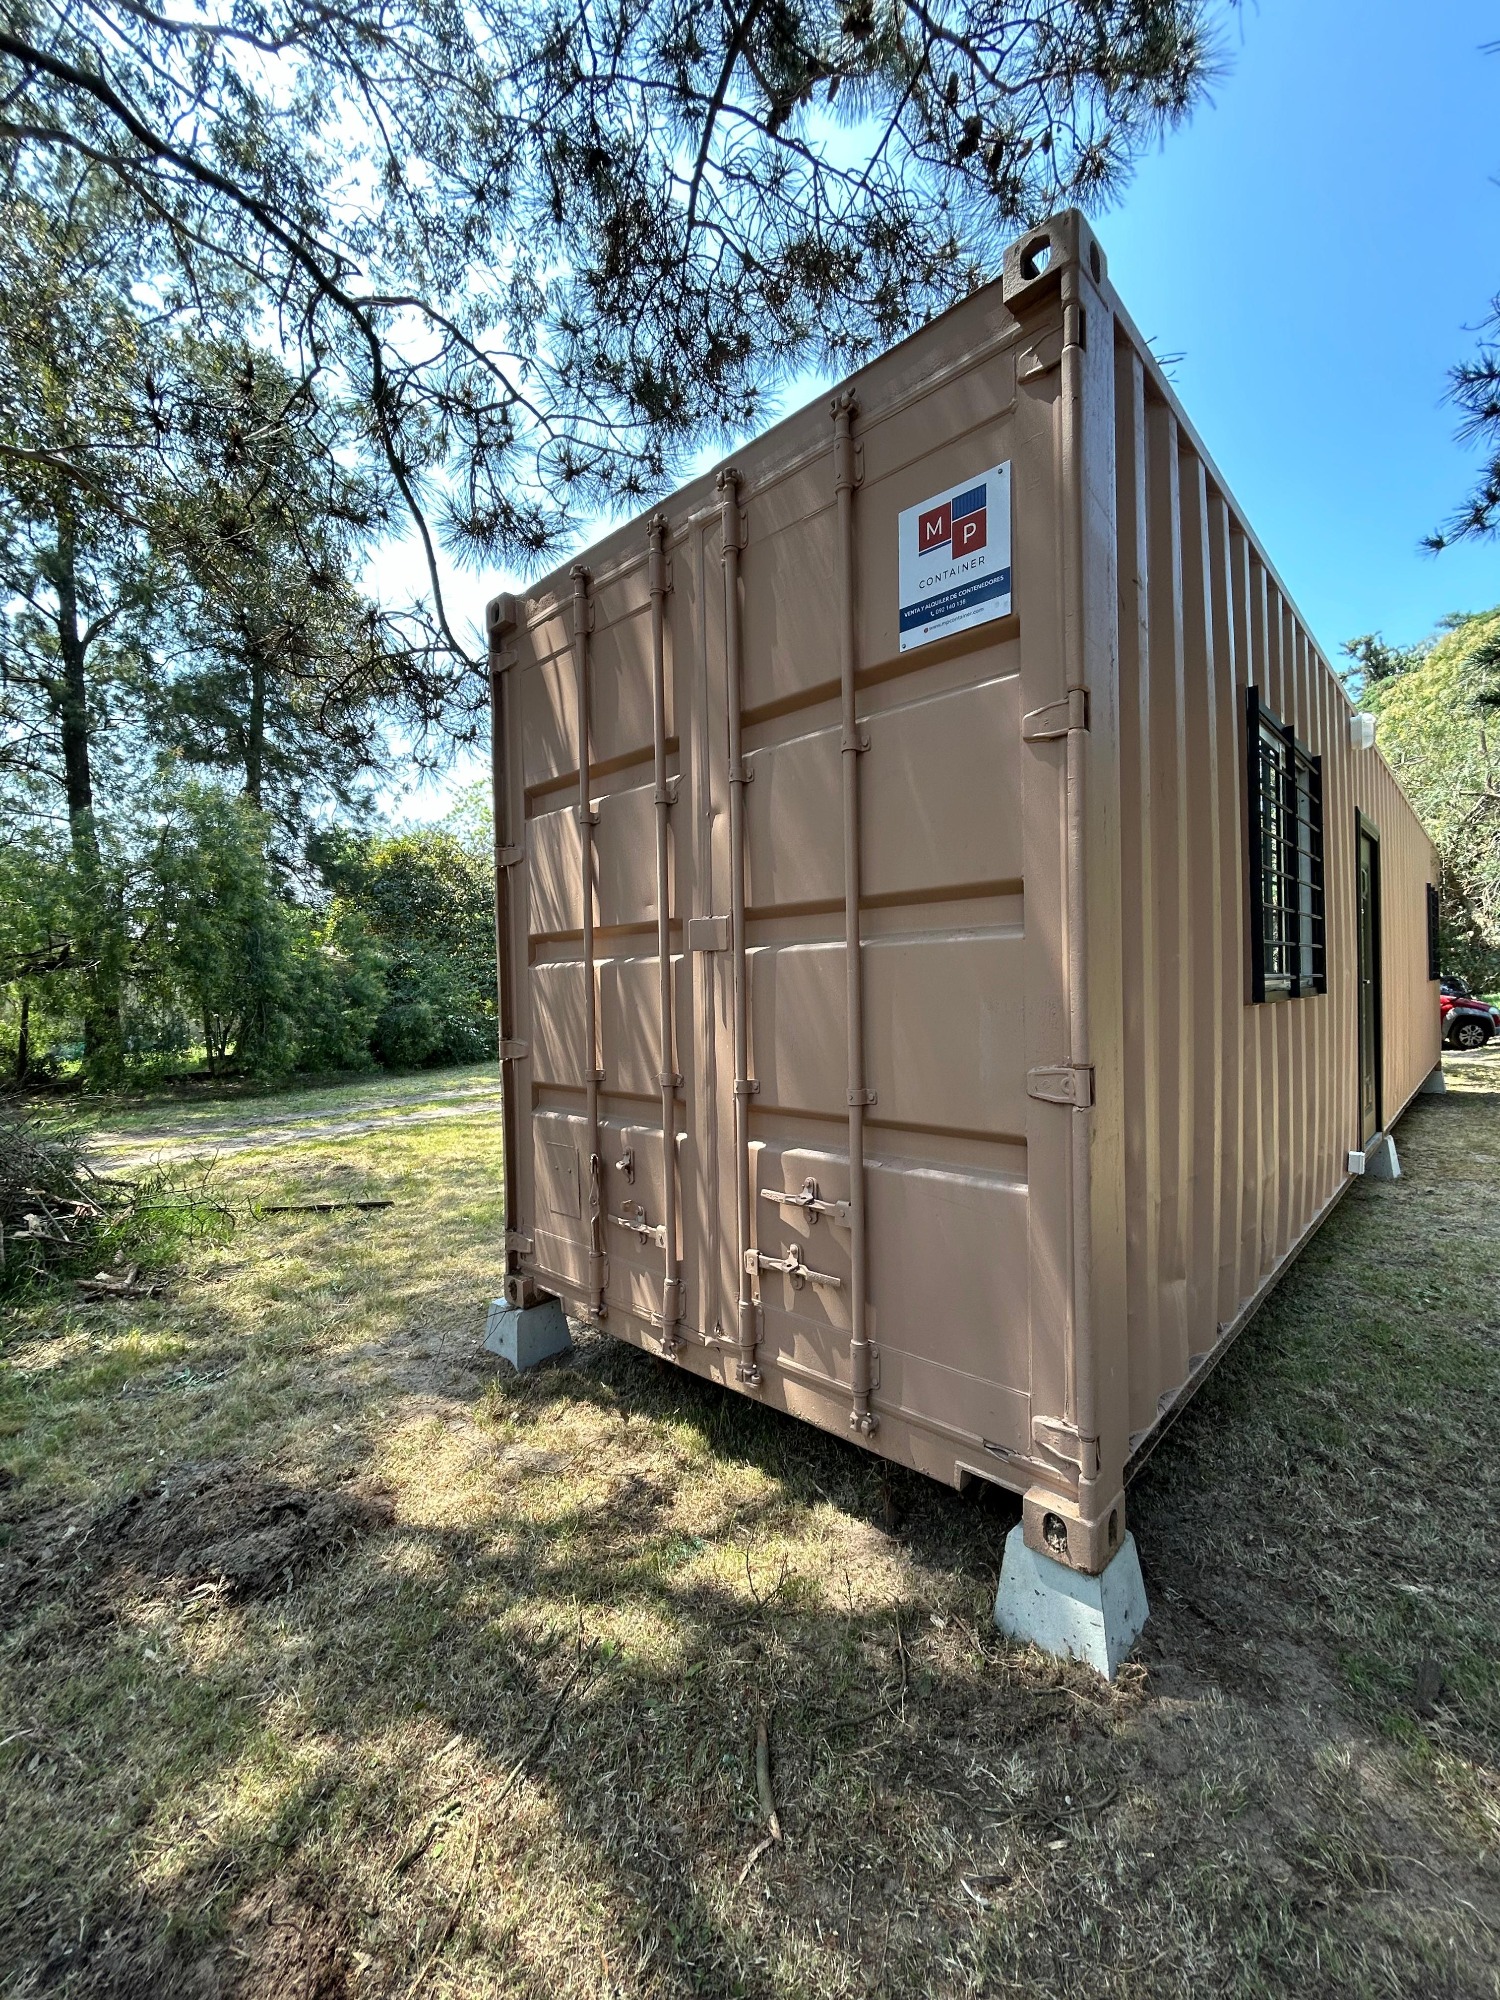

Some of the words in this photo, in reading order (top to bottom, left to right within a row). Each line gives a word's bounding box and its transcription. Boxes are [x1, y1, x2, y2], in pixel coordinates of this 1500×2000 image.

[926, 516, 942, 540] M
[963, 522, 977, 544] P
[919, 556, 985, 589] CONTAINER
[904, 607, 920, 618] VENTA
[925, 596, 950, 610] ALQUILER
[950, 592, 957, 600] DE
[958, 575, 1004, 597] CONTENEDORES
[929, 607, 985, 631] www.mpcontainer.com
